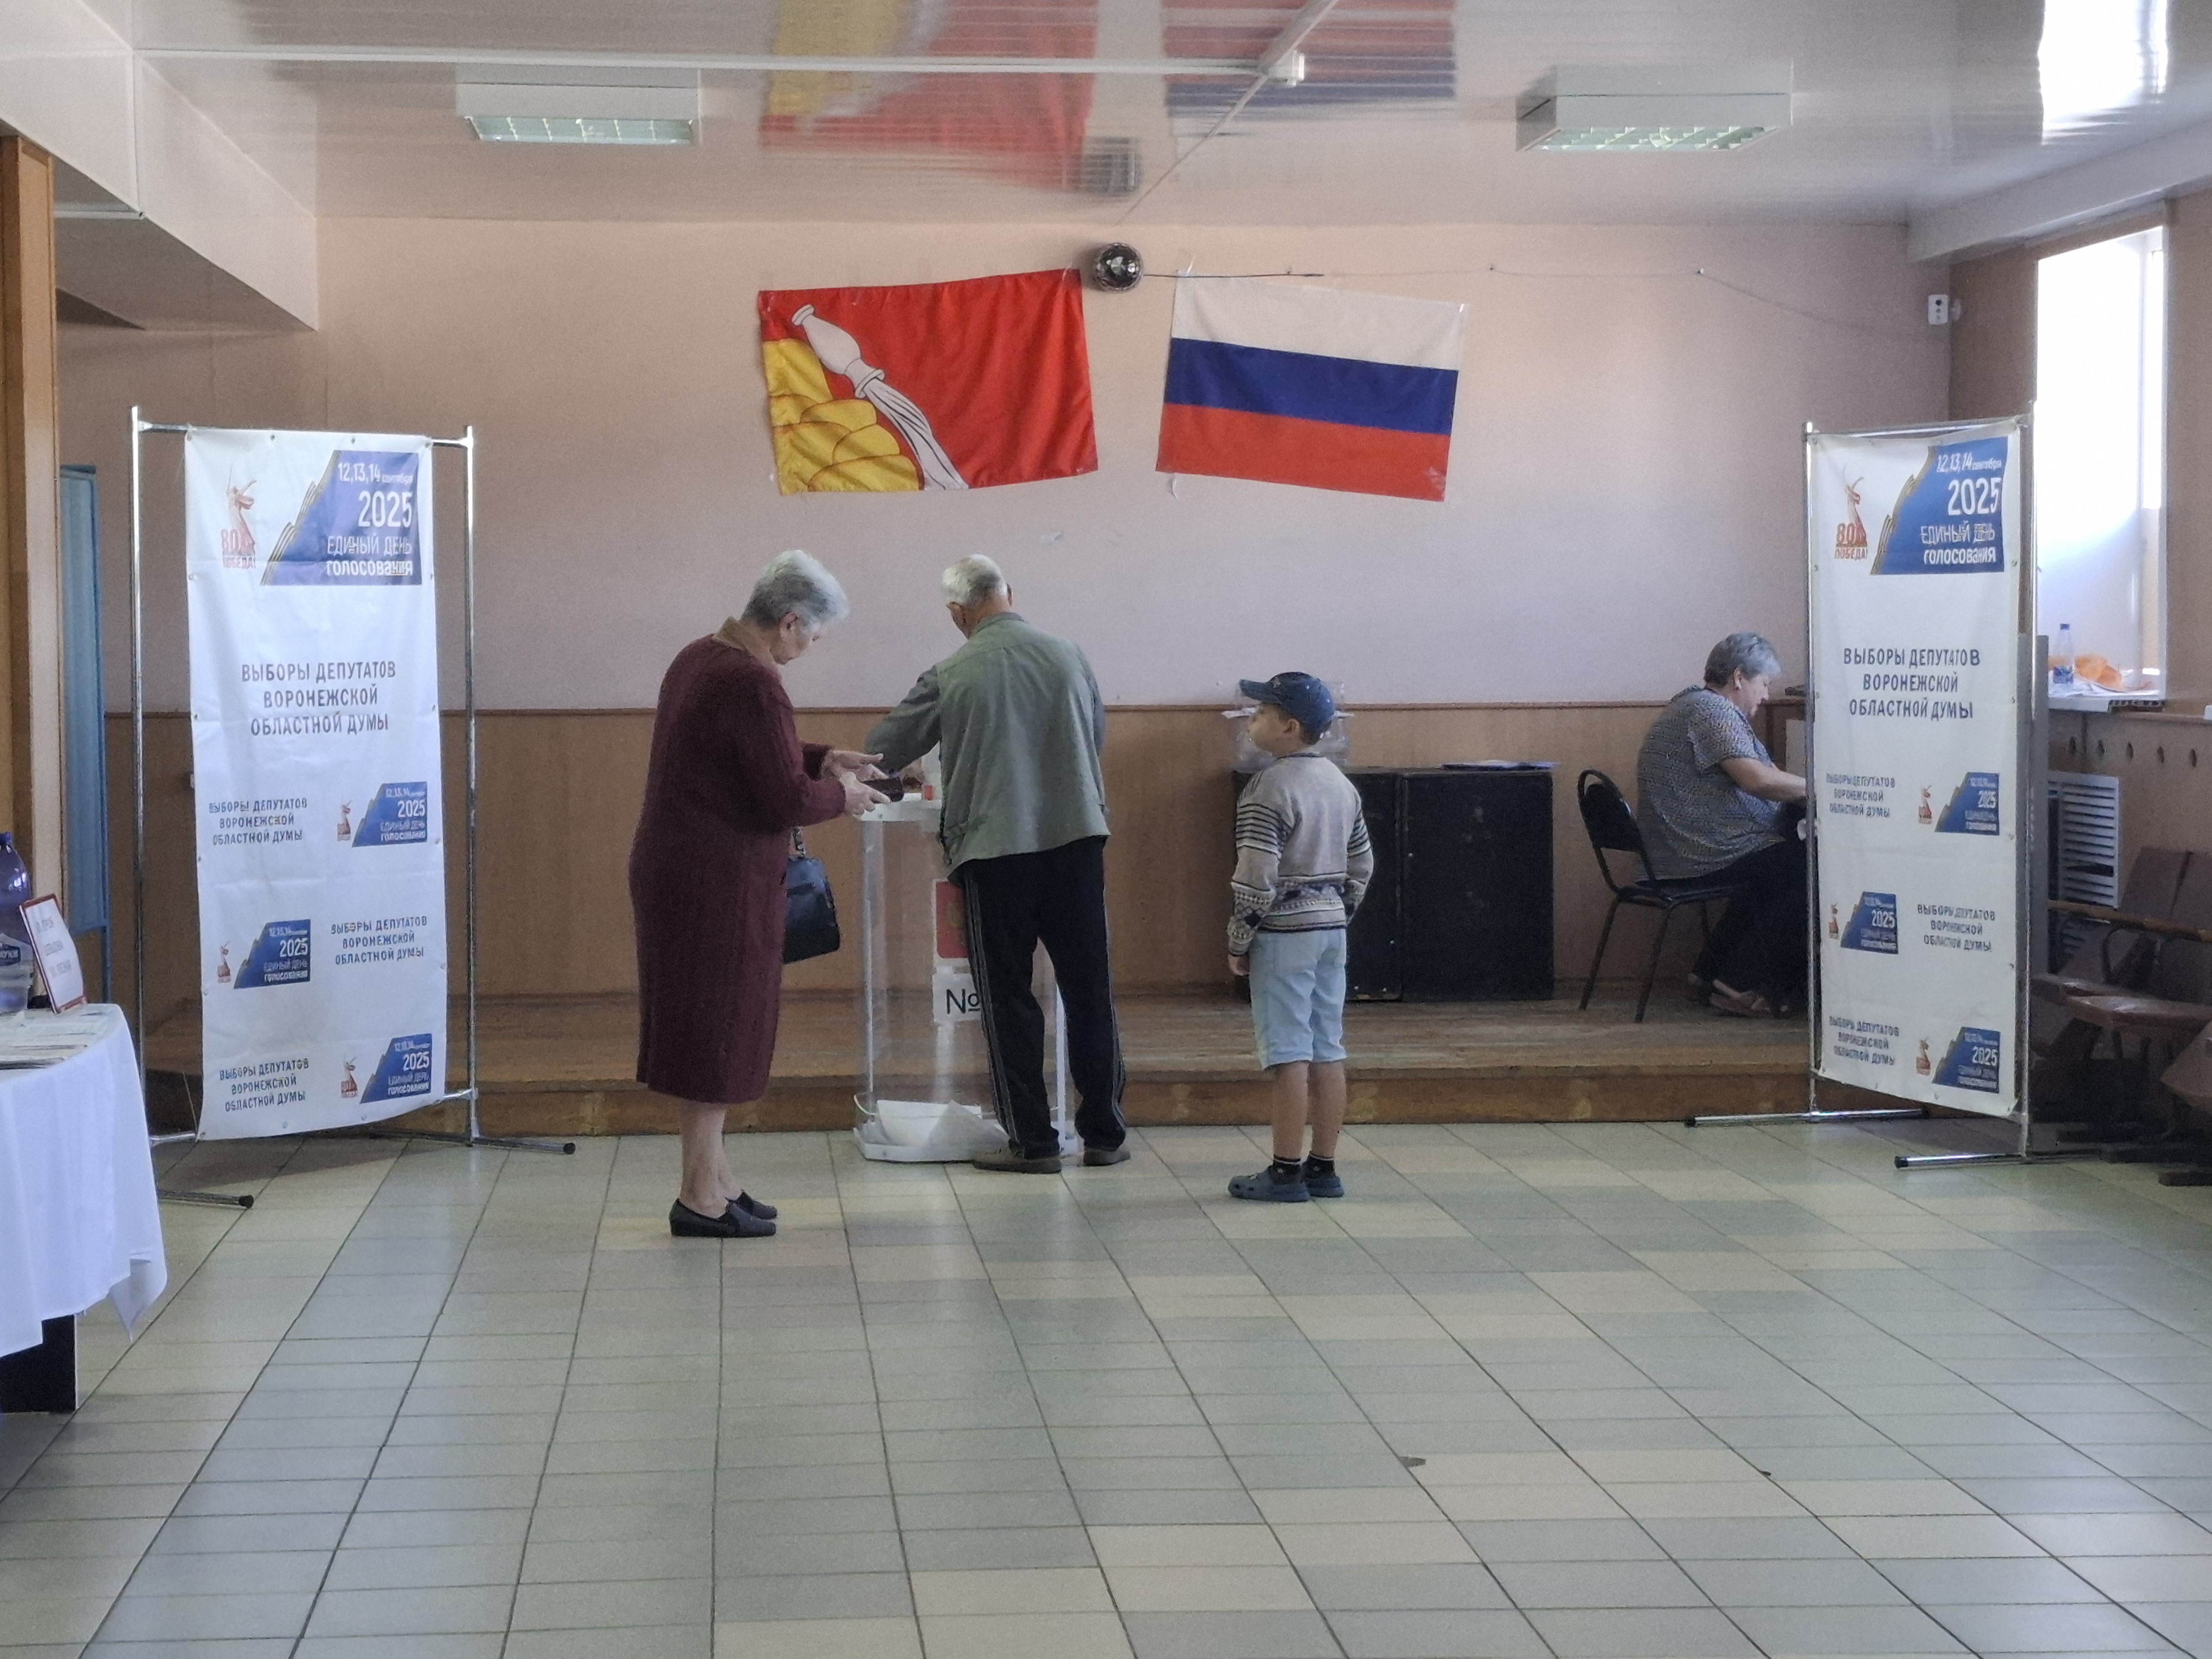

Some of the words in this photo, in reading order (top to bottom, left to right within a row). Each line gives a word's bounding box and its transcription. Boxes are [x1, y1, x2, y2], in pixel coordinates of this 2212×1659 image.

[1948, 478, 2002, 516] 2025
[358, 491, 413, 528] 2025
[1920, 520, 1971, 545] ЕДИНЫЙ
[327, 532, 379, 556] ЕДИНЫЙ
[384, 536, 412, 557] ДЕНЬ
[1843, 648, 1905, 665] ВЫБОРЫ
[1908, 648, 1980, 669] ДЕПУТАТОВ
[242, 663, 310, 681] ВЫБОРЫ
[316, 661, 396, 684] ДЕПУТАТОВ
[1863, 671, 1958, 692] ВОРОНЕЖСКОЙ
[263, 683, 377, 708] ВОРОНЕЖСКОЙ
[1849, 697, 1928, 718] ОБЛАСТНОЙ
[1931, 702, 1973, 722] ДУМЫ
[250, 711, 342, 736] ОБЛАСТНОЙ
[347, 713, 388, 735] ДУМЫ
[253, 798, 307, 813] ДЕПУТАТОВ
[397, 799, 425, 818] 2025
[213, 830, 269, 846] ОБЛАСТНОЙ
[272, 829, 303, 844] ДУМЫ
[331, 921, 372, 934] ВЫБОРЫ
[376, 916, 427, 931] ДЕПУТАТОВ
[1871, 909, 1895, 928] 2025
[280, 937, 308, 958] 2025
[343, 930, 415, 949] ВОРОНЕЖСКОЙ
[335, 948, 394, 965] ОБЛАСТНОЙ
[397, 947, 424, 961] ДУМЫ
[403, 1051, 429, 1071] 2025
[1972, 1046, 1998, 1066] 2025
[259, 1058, 309, 1077] ДЕПУТАТОВ
[232, 1073, 297, 1095] ВОРОНЕЖСКОЙ
[225, 1092, 274, 1112] ОБЛАСТНОЙ
[277, 1091, 305, 1106] ДУМЫ
